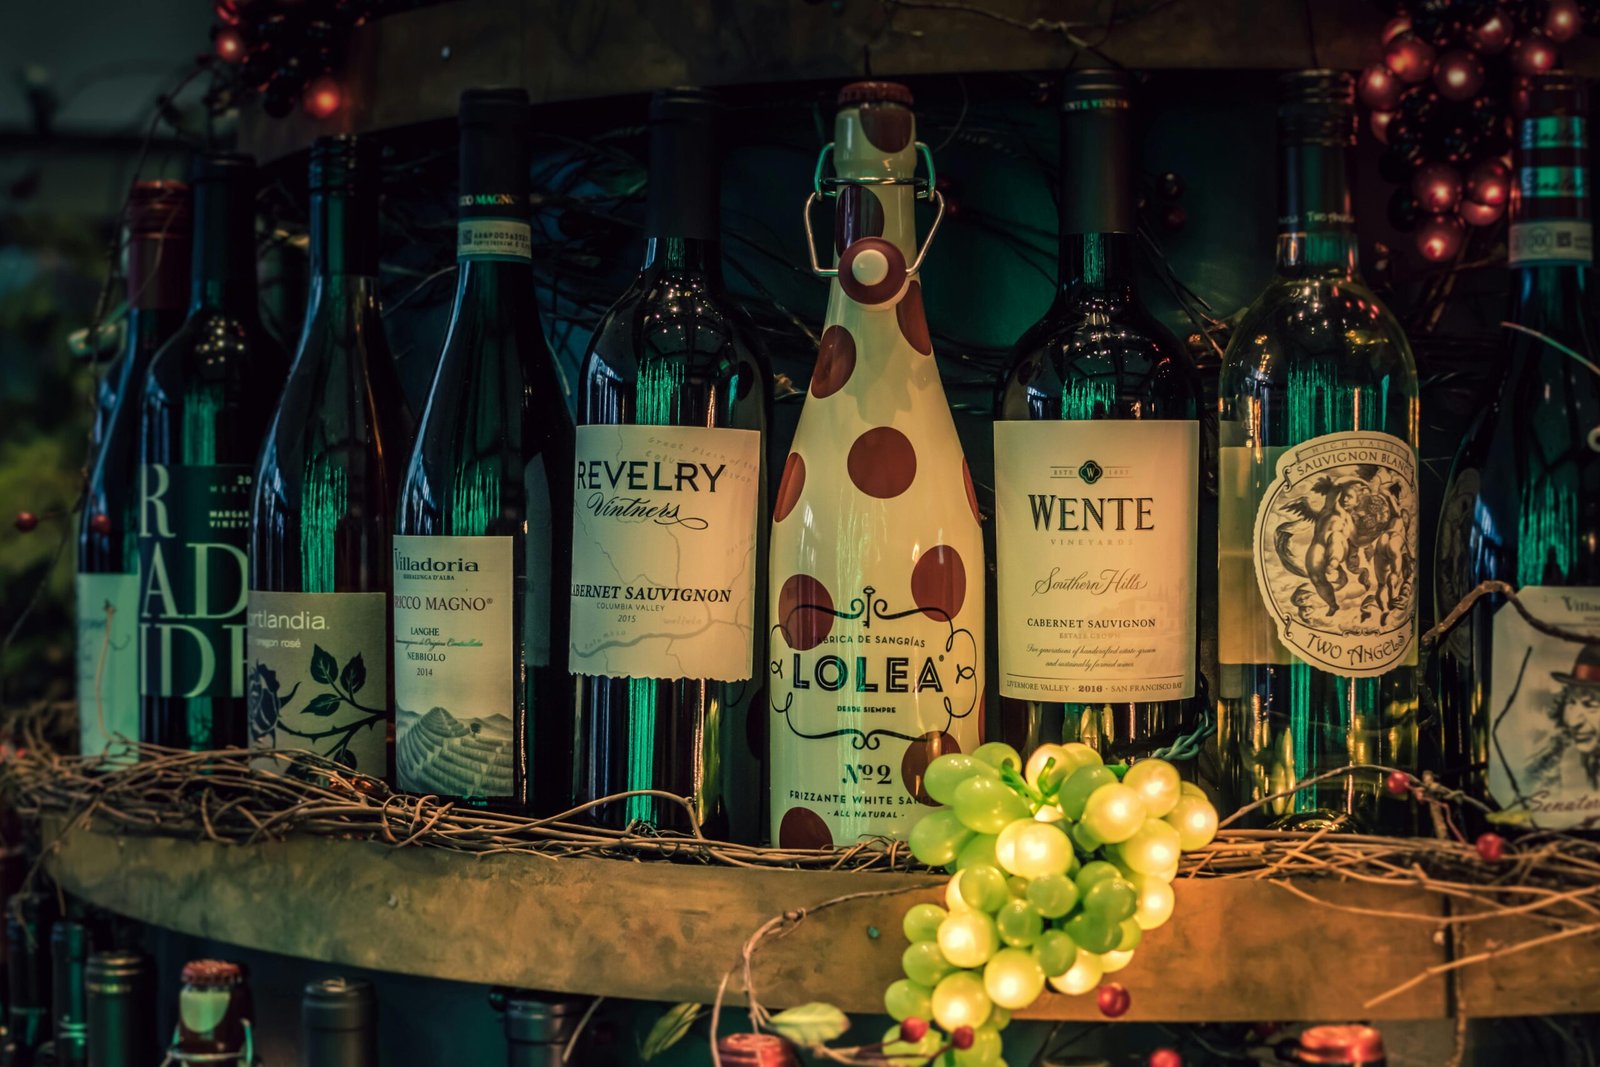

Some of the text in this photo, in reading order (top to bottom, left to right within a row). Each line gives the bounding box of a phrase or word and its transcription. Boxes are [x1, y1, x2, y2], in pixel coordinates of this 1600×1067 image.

[1297, 451, 1411, 476] SAUVIGNON BLANC
[577, 461, 727, 493] REVELRY
[586, 492, 709, 530] Vintners
[1027, 494, 1155, 532] WENTE
[394, 548, 480, 572] Villadoria
[1031, 567, 1149, 597] Southern Hills
[625, 586, 733, 603] SAUVIGNON
[597, 602, 666, 612] COLUMBIA VALLEY
[617, 614, 637, 623] 2015
[1027, 618, 1157, 629] CABERNET SAUVIGNON
[410, 626, 440, 636] LANGHE
[858, 635, 871, 644] DE
[875, 635, 926, 648] SANGRÍAS
[1308, 631, 1411, 667] TWO ANGELS
[407, 651, 446, 662] NEBBIOLO
[416, 668, 433, 677] 2014
[1007, 679, 1038, 691] LIVERMORE
[1040, 684, 1069, 692] VALLEY
[1110, 684, 1128, 693] SAN
[1129, 682, 1172, 692] FRANCISCO
[836, 705, 897, 714] DESDE SIEMPRE
[876, 764, 893, 785] 2
[789, 790, 847, 804] FRIZZANTE
[852, 796, 893, 805] WHITE
[834, 810, 898, 819] ALL NATURAL
